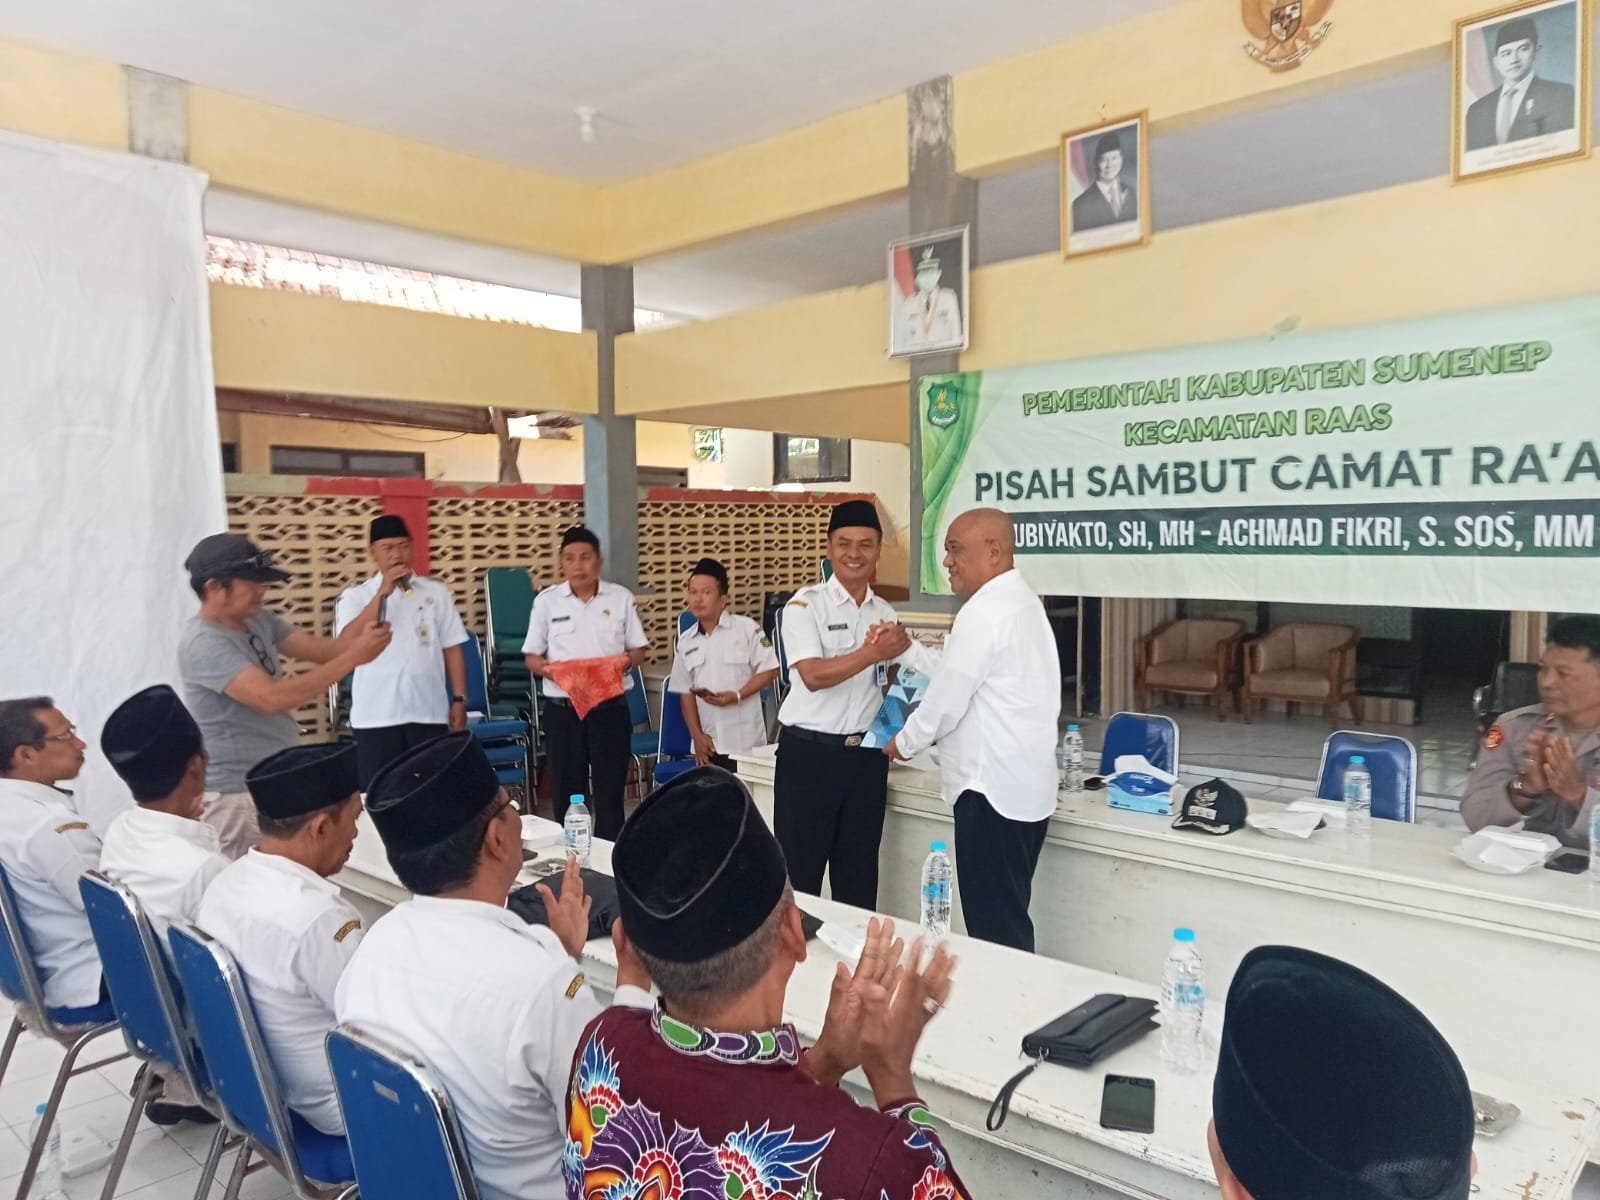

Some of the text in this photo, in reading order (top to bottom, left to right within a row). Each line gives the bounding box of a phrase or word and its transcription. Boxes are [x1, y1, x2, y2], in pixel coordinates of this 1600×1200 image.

[1022, 339, 1553, 416] PEMERINTAH KABUPATEN SUMENEP
[1123, 402, 1393, 447] KECAMATAN RAAS
[974, 439, 1600, 502] PISAH SAMBUT CAMAT RA'A
[1013, 519, 1113, 551] UBIYAKTO,
[1117, 520, 1154, 551] SH,
[1159, 519, 1195, 547] MH
[1217, 517, 1324, 547] ACHMAD
[1330, 515, 1411, 551] FIKRI,
[1418, 515, 1447, 548] S.
[1533, 514, 1595, 547] MM
